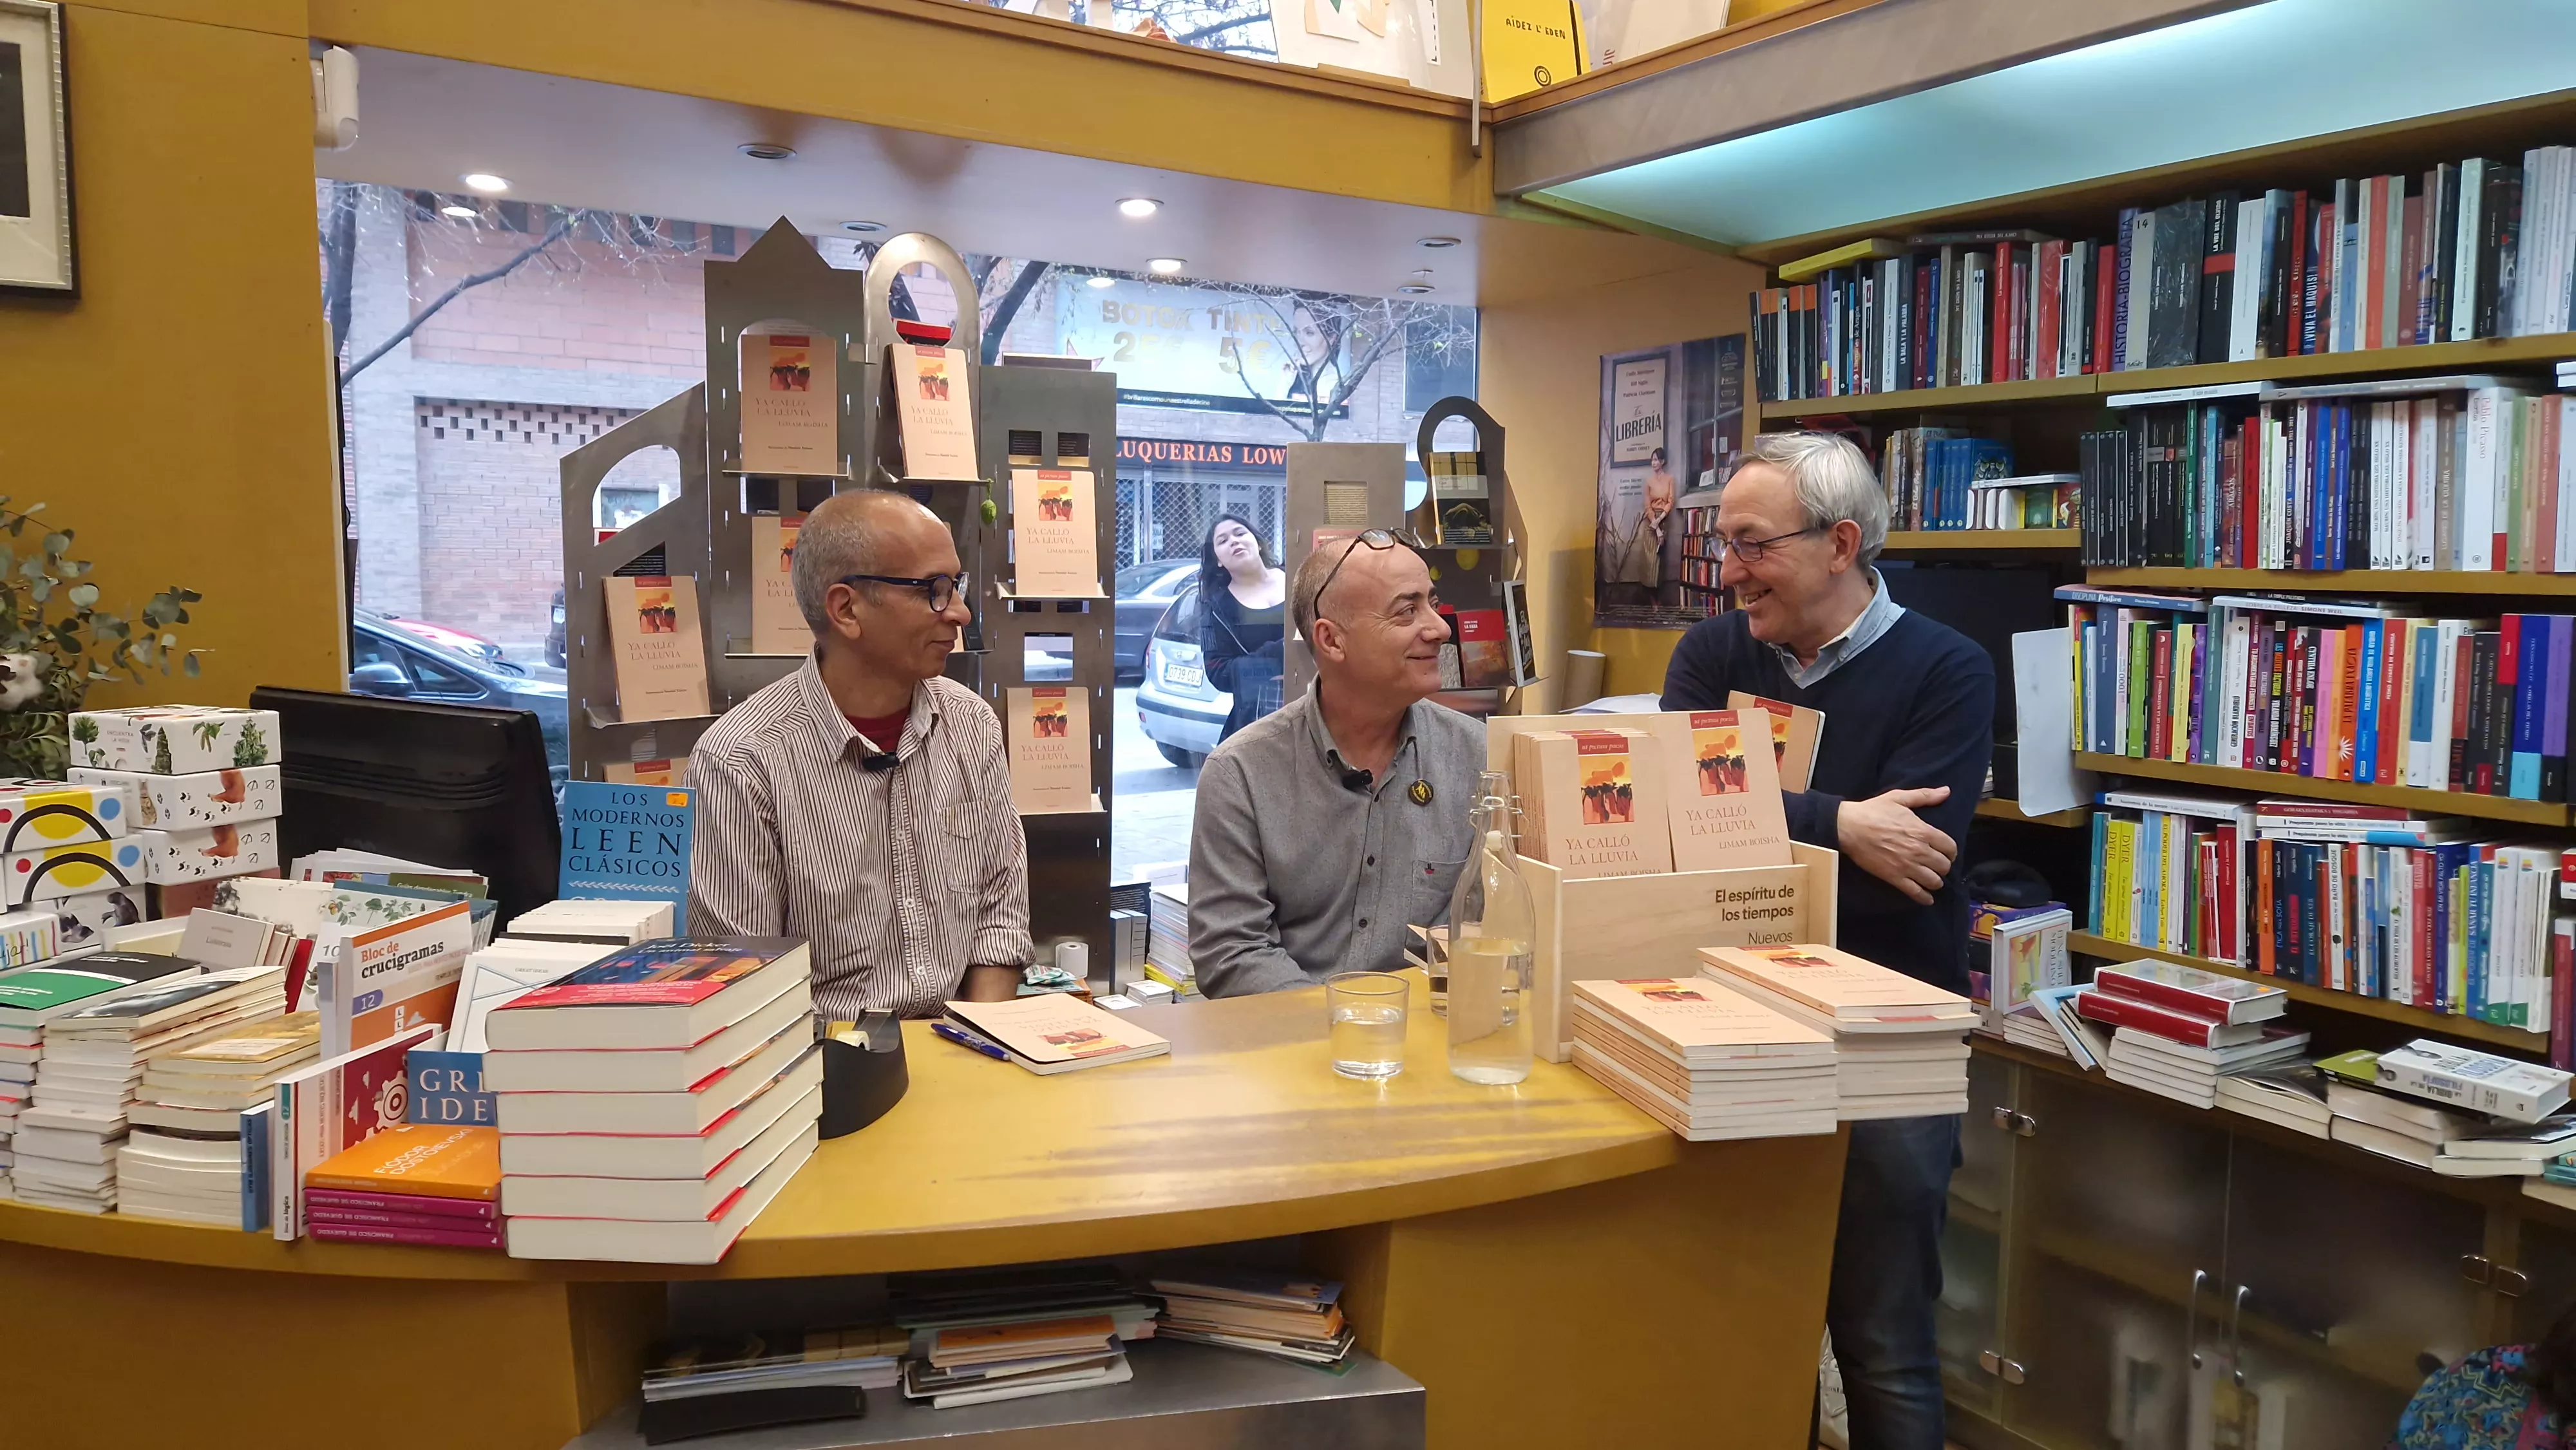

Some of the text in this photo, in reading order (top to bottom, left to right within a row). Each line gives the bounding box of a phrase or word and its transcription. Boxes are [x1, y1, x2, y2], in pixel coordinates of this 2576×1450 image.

[1546, 26, 1566, 40] EDEN
[2137, 220, 2148, 229] 14
[2306, 309, 2316, 318] EL
[1616, 410, 1662, 442] LIBRERÍA
[2479, 397, 2490, 459] Pablo Picasso
[1242, 446, 1287, 465] LOW
[1043, 536, 1074, 545] LLUVIA
[2098, 594, 2121, 603] Positiva
[628, 643, 641, 651] YA
[2307, 646, 2316, 670] CYNTHIA
[612, 792, 649, 806] LOS
[572, 808, 685, 827] MODERNOS
[1685, 804, 1747, 822] YA CALLÓ
[1690, 819, 1756, 836] LA LLUVIA
[571, 827, 683, 856] LEEN
[1566, 834, 1630, 851] YA CALLÓ
[1719, 836, 1780, 849] LIMAM BOISHA
[2108, 831, 2117, 860] DYER
[2121, 835, 2131, 863] DYER
[569, 854, 681, 878] CLÁSICOS
[1569, 851, 1639, 865] LA LLUVIA
[1716, 885, 1794, 904] El espíritu de
[1722, 907, 1794, 921] los tiempos
[1748, 932, 1793, 945] Nuevos
[361, 941, 399, 963] Bloc de
[361, 941, 444, 979] crucigramas
[361, 995, 375, 1010] 12
[282, 1106, 289, 1116] 12
[389, 1129, 473, 1175] DOSTOIEVSKI
